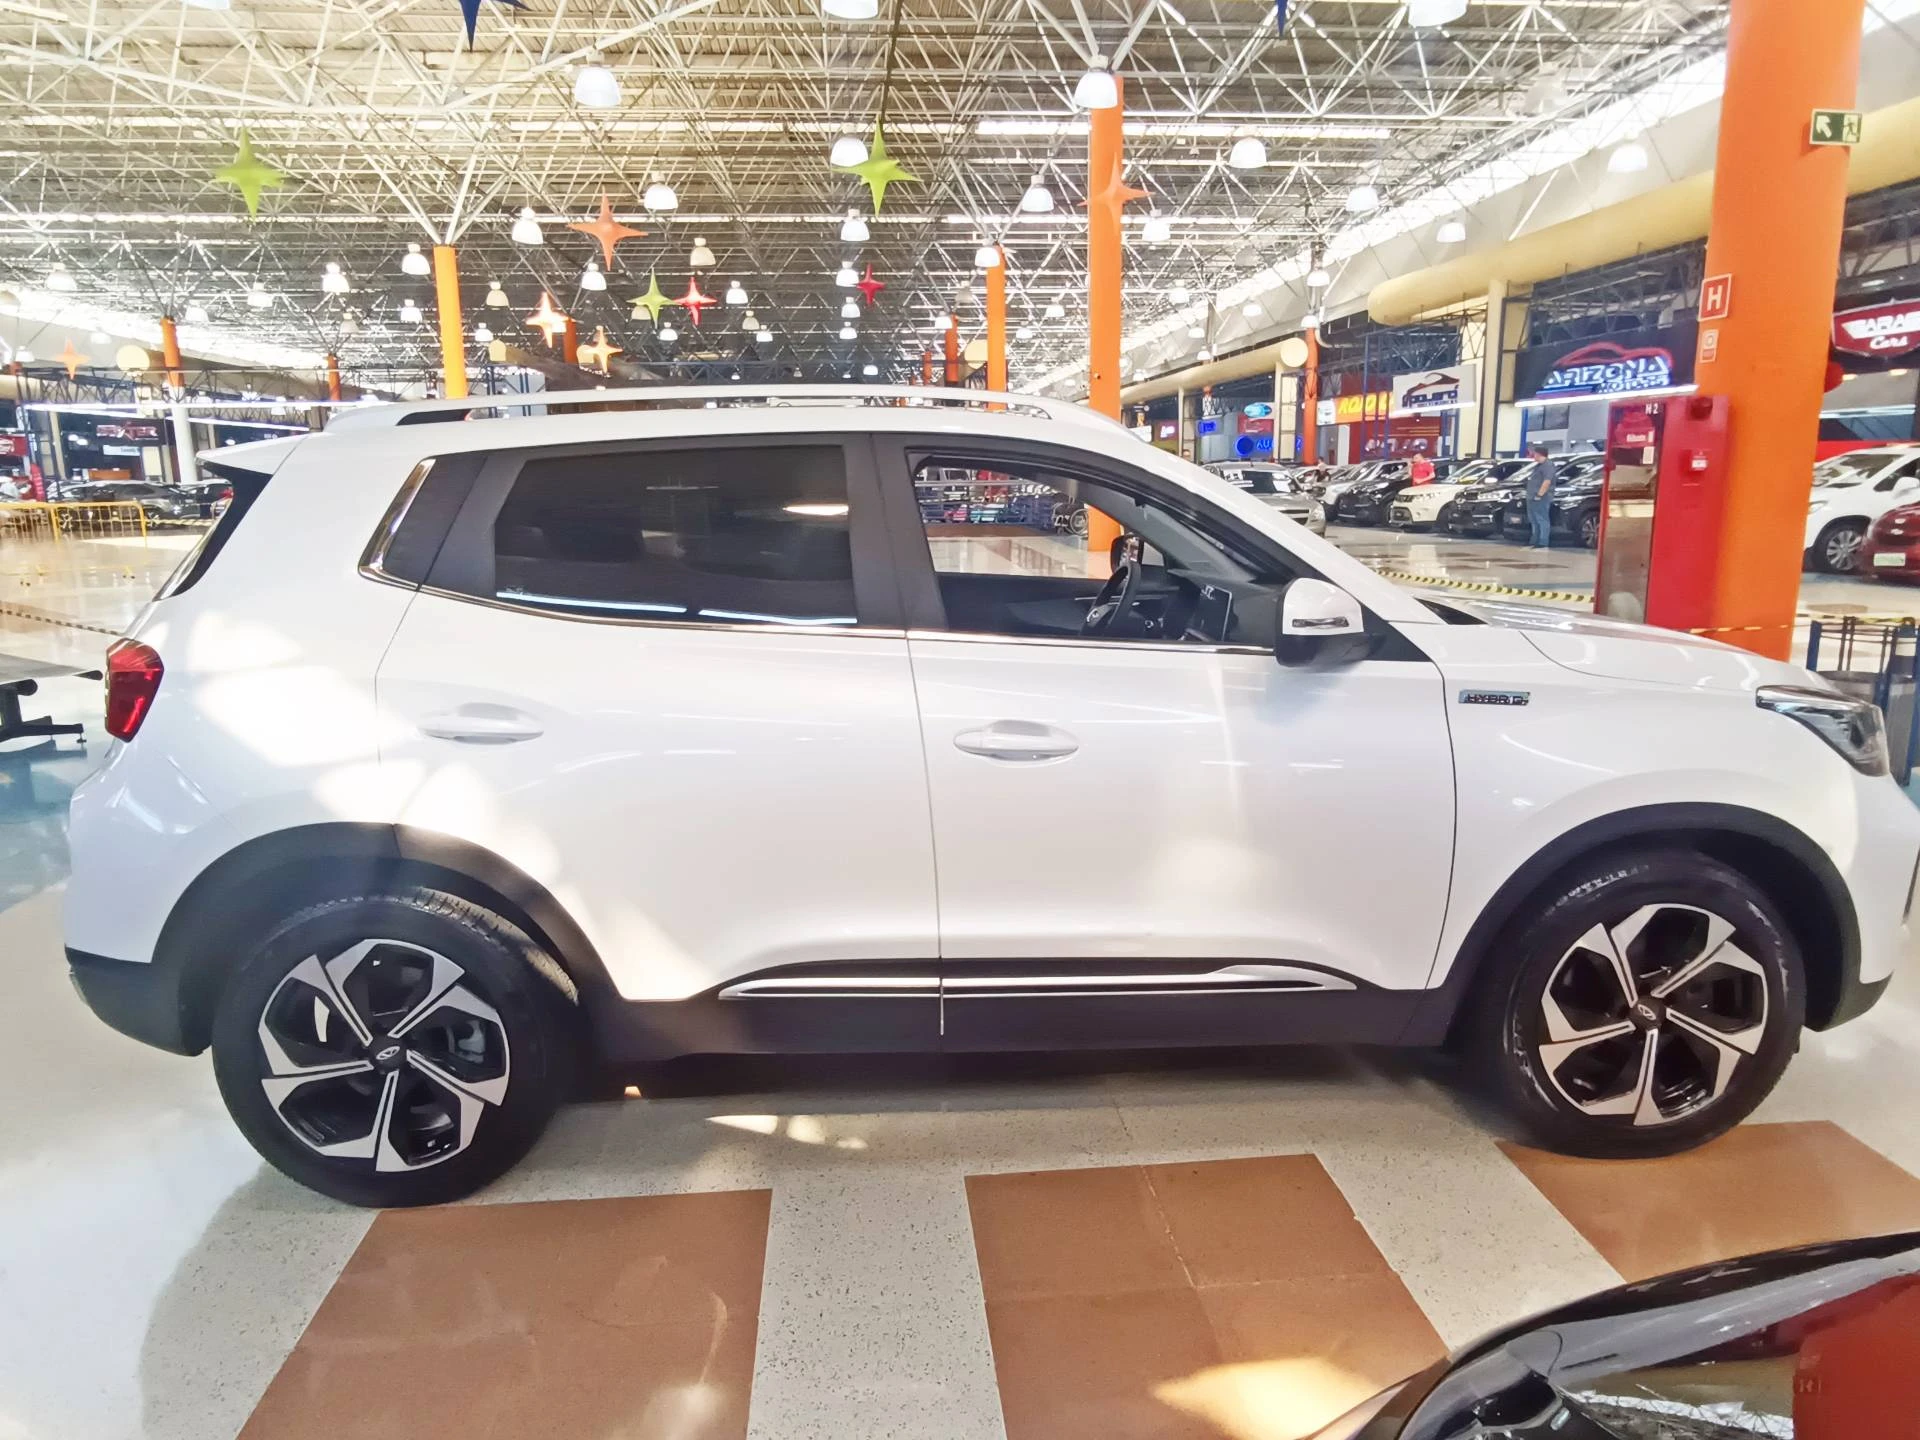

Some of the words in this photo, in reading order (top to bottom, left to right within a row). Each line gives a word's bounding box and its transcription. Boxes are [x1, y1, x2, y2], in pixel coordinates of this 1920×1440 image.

[1706, 284, 1723, 311] H
[1870, 335, 1908, 350] Cars
[1543, 356, 1670, 389] ARIZONA
